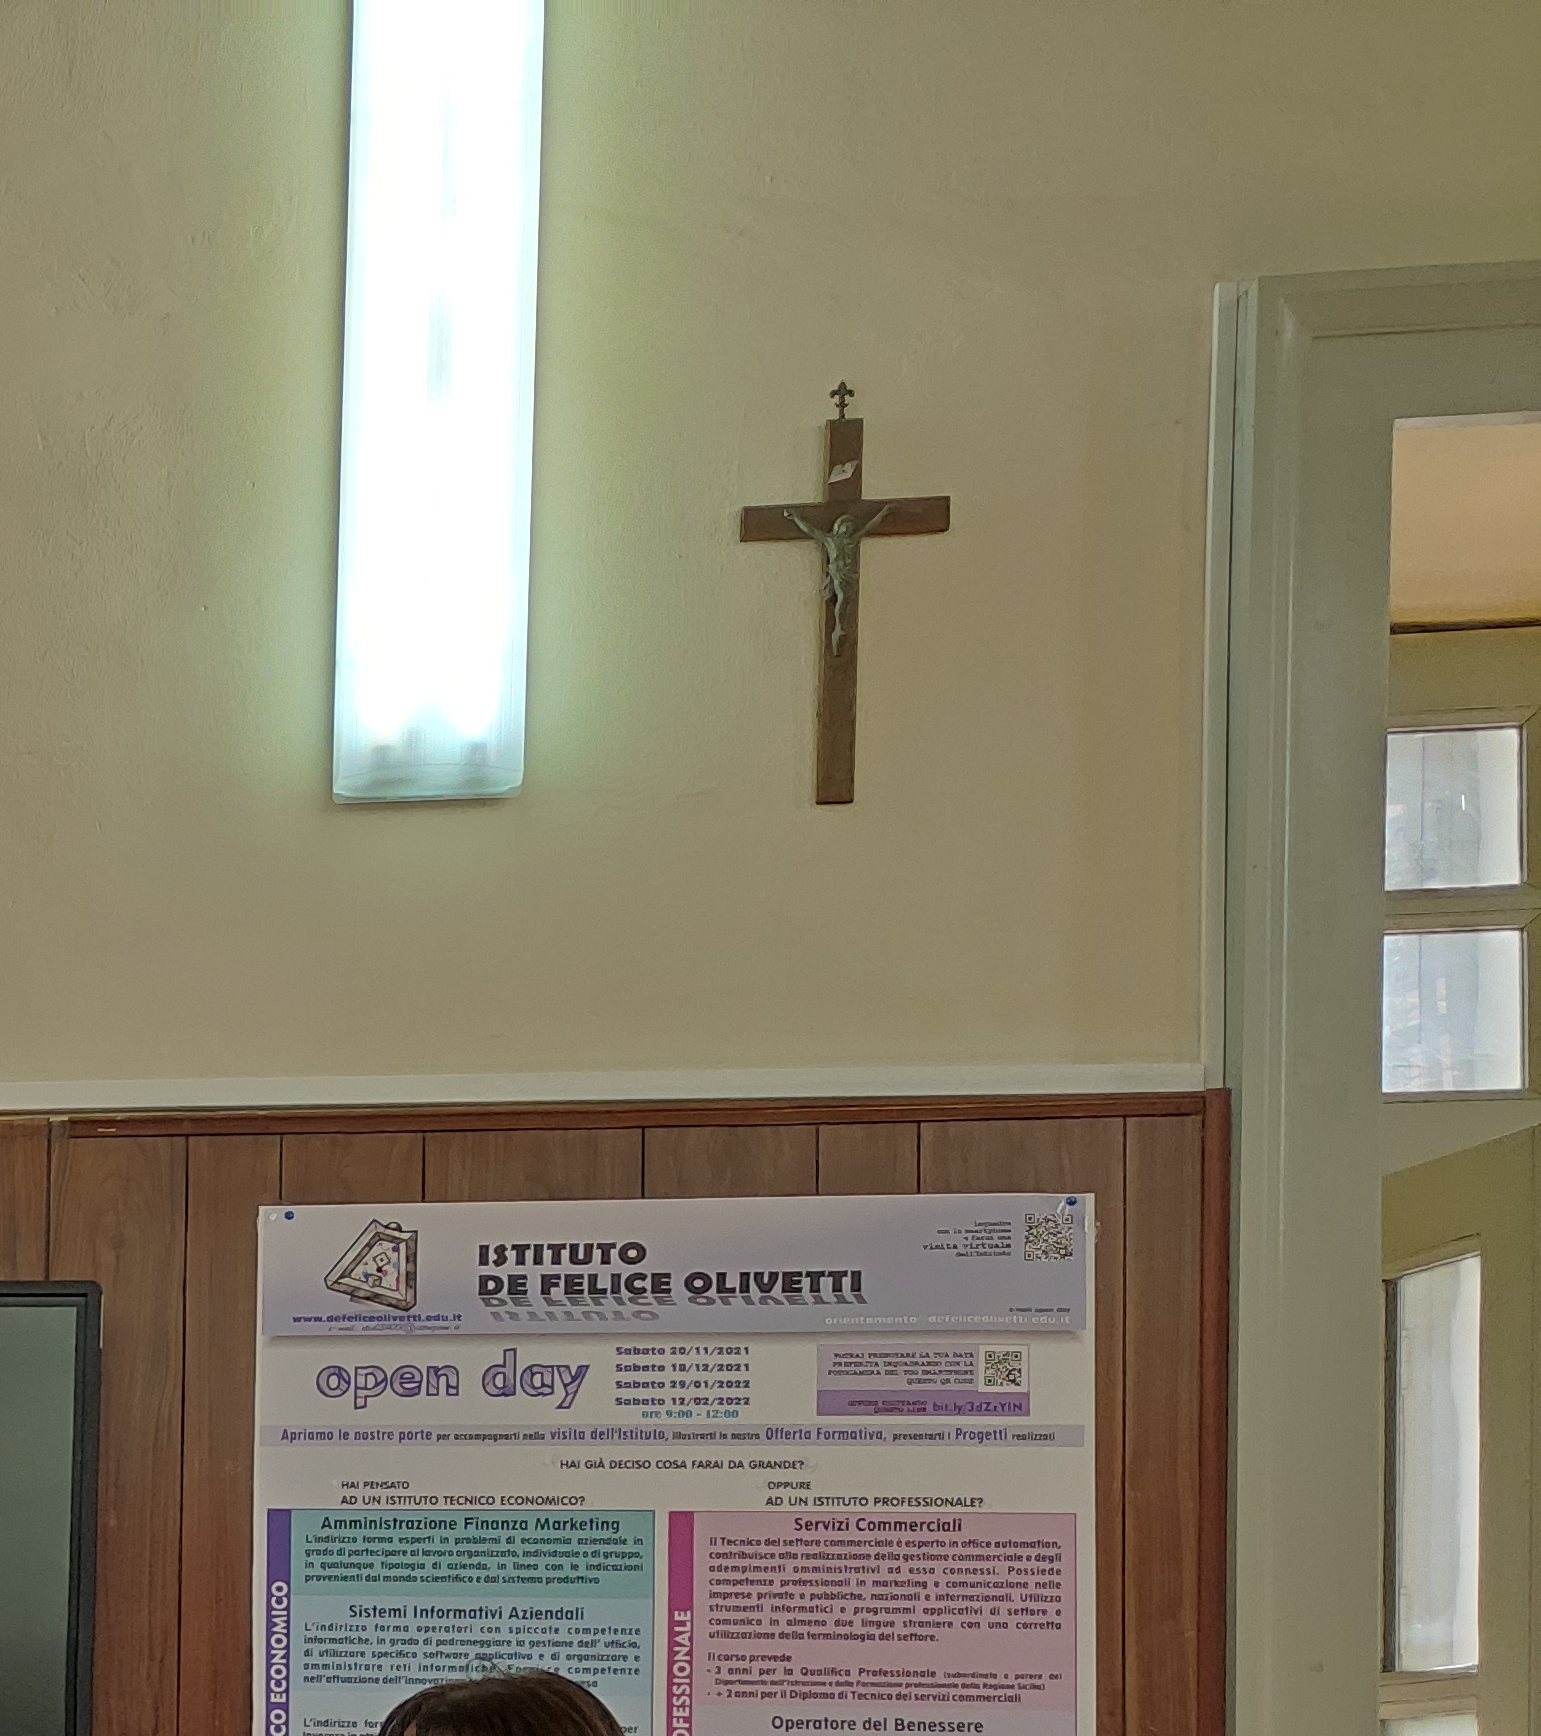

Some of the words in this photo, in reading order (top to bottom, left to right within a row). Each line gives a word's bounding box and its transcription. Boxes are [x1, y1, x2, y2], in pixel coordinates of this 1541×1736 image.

[478, 1241, 647, 1267] ISTITUTO
[478, 1274, 528, 1296] DE
[540, 1273, 672, 1295] FELICE
[684, 1270, 862, 1295] OLIVETTI
[615, 1346, 666, 1356] Sabato
[670, 1346, 750, 1356] 20/11/2021
[615, 1363, 666, 1372] Sabato
[316, 1364, 460, 1409] open
[482, 1346, 591, 1409] day
[615, 1380, 666, 1389] Sabato
[615, 1397, 666, 1406] Sabato
[280, 1427, 334, 1443] Apriamo
[338, 1428, 349, 1441] le
[354, 1429, 394, 1441] nostre
[398, 1430, 432, 1444] porte
[436, 1433, 450, 1443] per
[550, 1427, 586, 1441] visita
[766, 1427, 811, 1441] Offerta
[816, 1427, 887, 1443] Formativa,
[955, 1427, 1008, 1444] Progetti
[560, 1459, 581, 1469] HAI
[584, 1456, 606, 1469] GIÀ
[608, 1459, 652, 1469] DECISO
[656, 1459, 687, 1470] COSA
[691, 1460, 724, 1470] FARAI
[728, 1460, 745, 1470] DA
[748, 1460, 805, 1470] GRANDE?
[341, 1481, 360, 1490] HAI
[363, 1480, 410, 1490] PENSATO
[767, 1481, 812, 1490] OPPURE
[340, 1495, 358, 1506] AD
[362, 1495, 382, 1506] UN
[385, 1495, 439, 1506] ISTITUTO
[442, 1495, 496, 1506] TECNICO
[500, 1495, 586, 1506] ECONOMICO?
[765, 1496, 783, 1507] AD
[788, 1496, 809, 1507] UN
[813, 1496, 869, 1507] ISTITUTO
[873, 1496, 984, 1508] PROFESSIONALE?
[321, 1516, 458, 1531] Amministrazione
[463, 1516, 529, 1531] Finanza
[534, 1516, 621, 1534] Marketing
[793, 1517, 850, 1533] Servizi
[855, 1517, 963, 1533] Commerciali
[348, 1604, 408, 1620] Sistemi
[413, 1604, 503, 1621] Informativi
[507, 1605, 585, 1621] Aziendali
[270, 1581, 289, 1704] ECONOMICO
[772, 1716, 858, 1734] Operatore
[862, 1716, 888, 1732] del
[894, 1717, 984, 1733] Benessere
